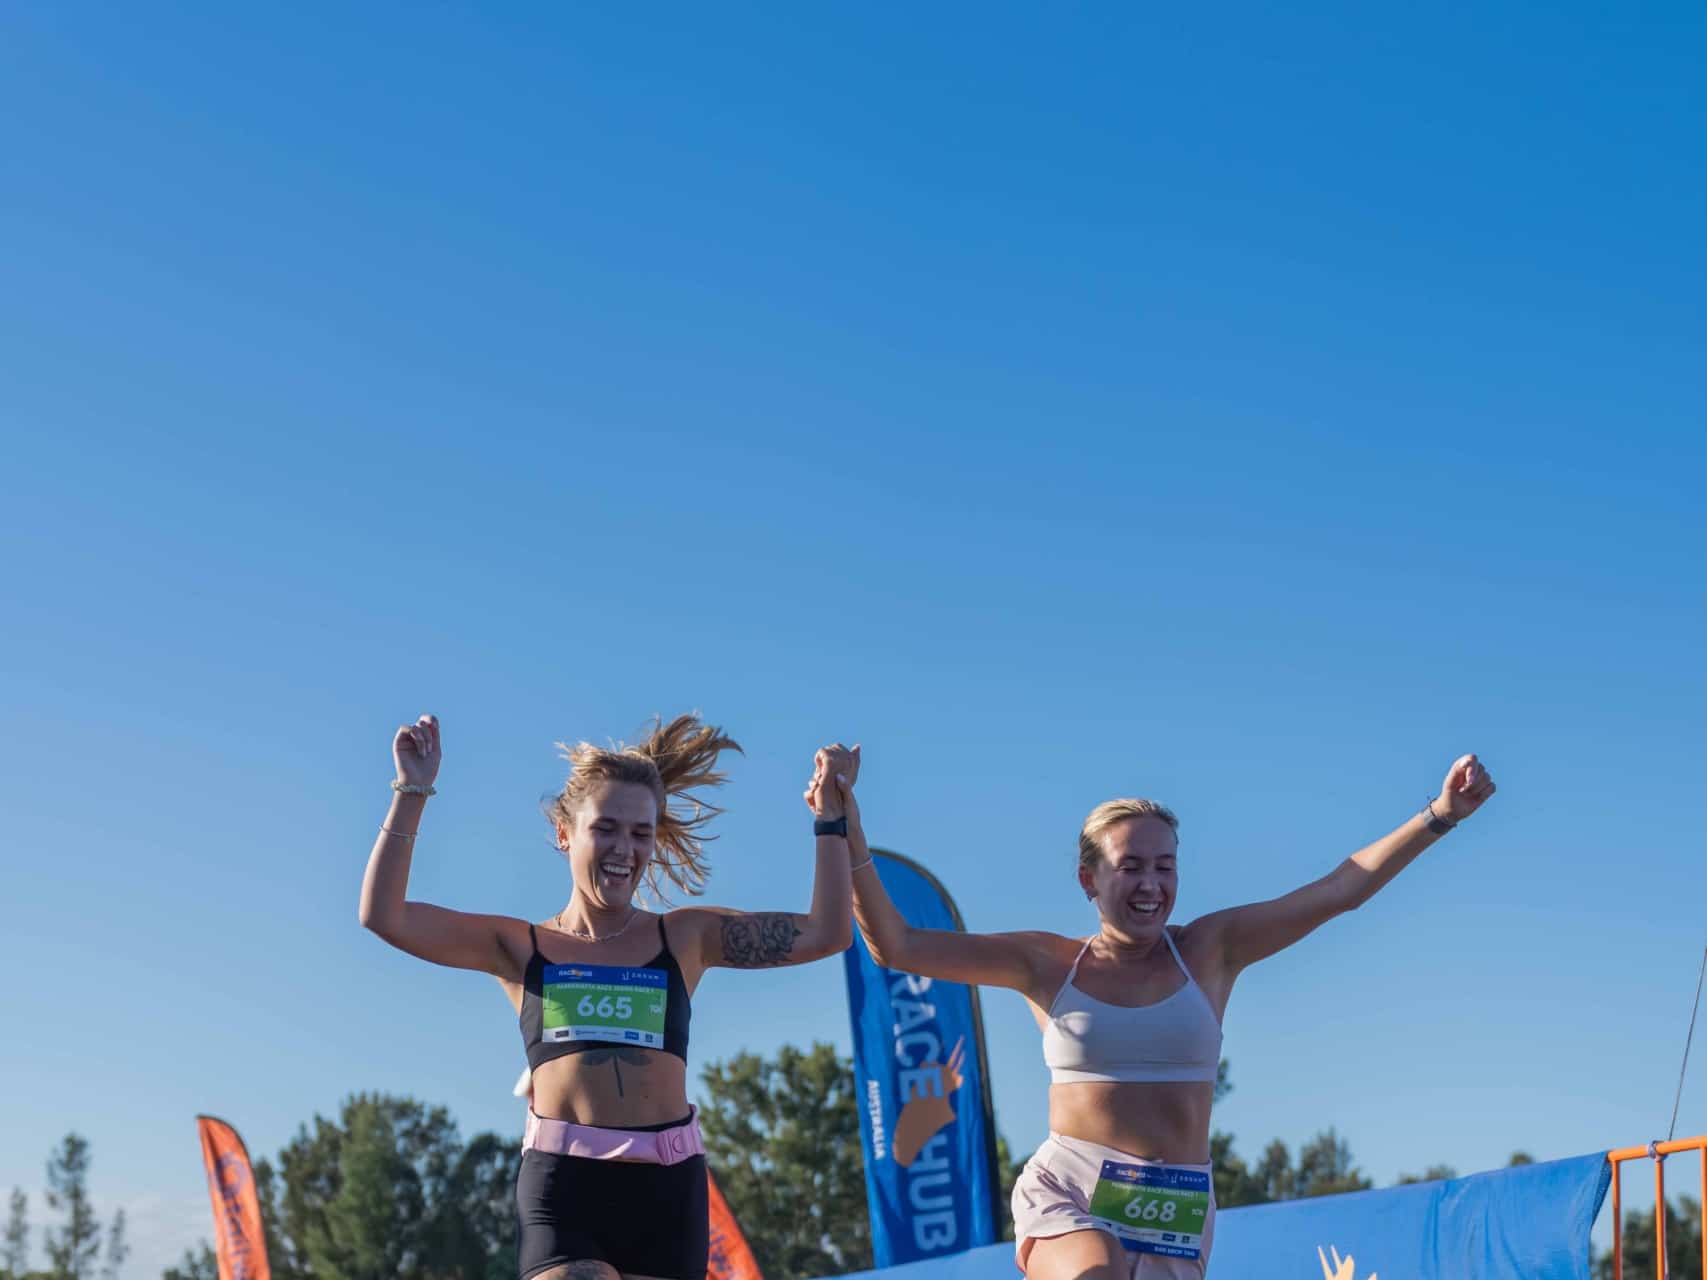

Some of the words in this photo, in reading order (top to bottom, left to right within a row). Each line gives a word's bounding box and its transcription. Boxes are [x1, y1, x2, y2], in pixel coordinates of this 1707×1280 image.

[577, 995, 633, 1019] 665
[889, 967, 944, 1104] RACE
[867, 1080, 886, 1160] AUSTRALIA
[908, 1133, 957, 1251] HUB
[1124, 1195, 1177, 1222] 668
